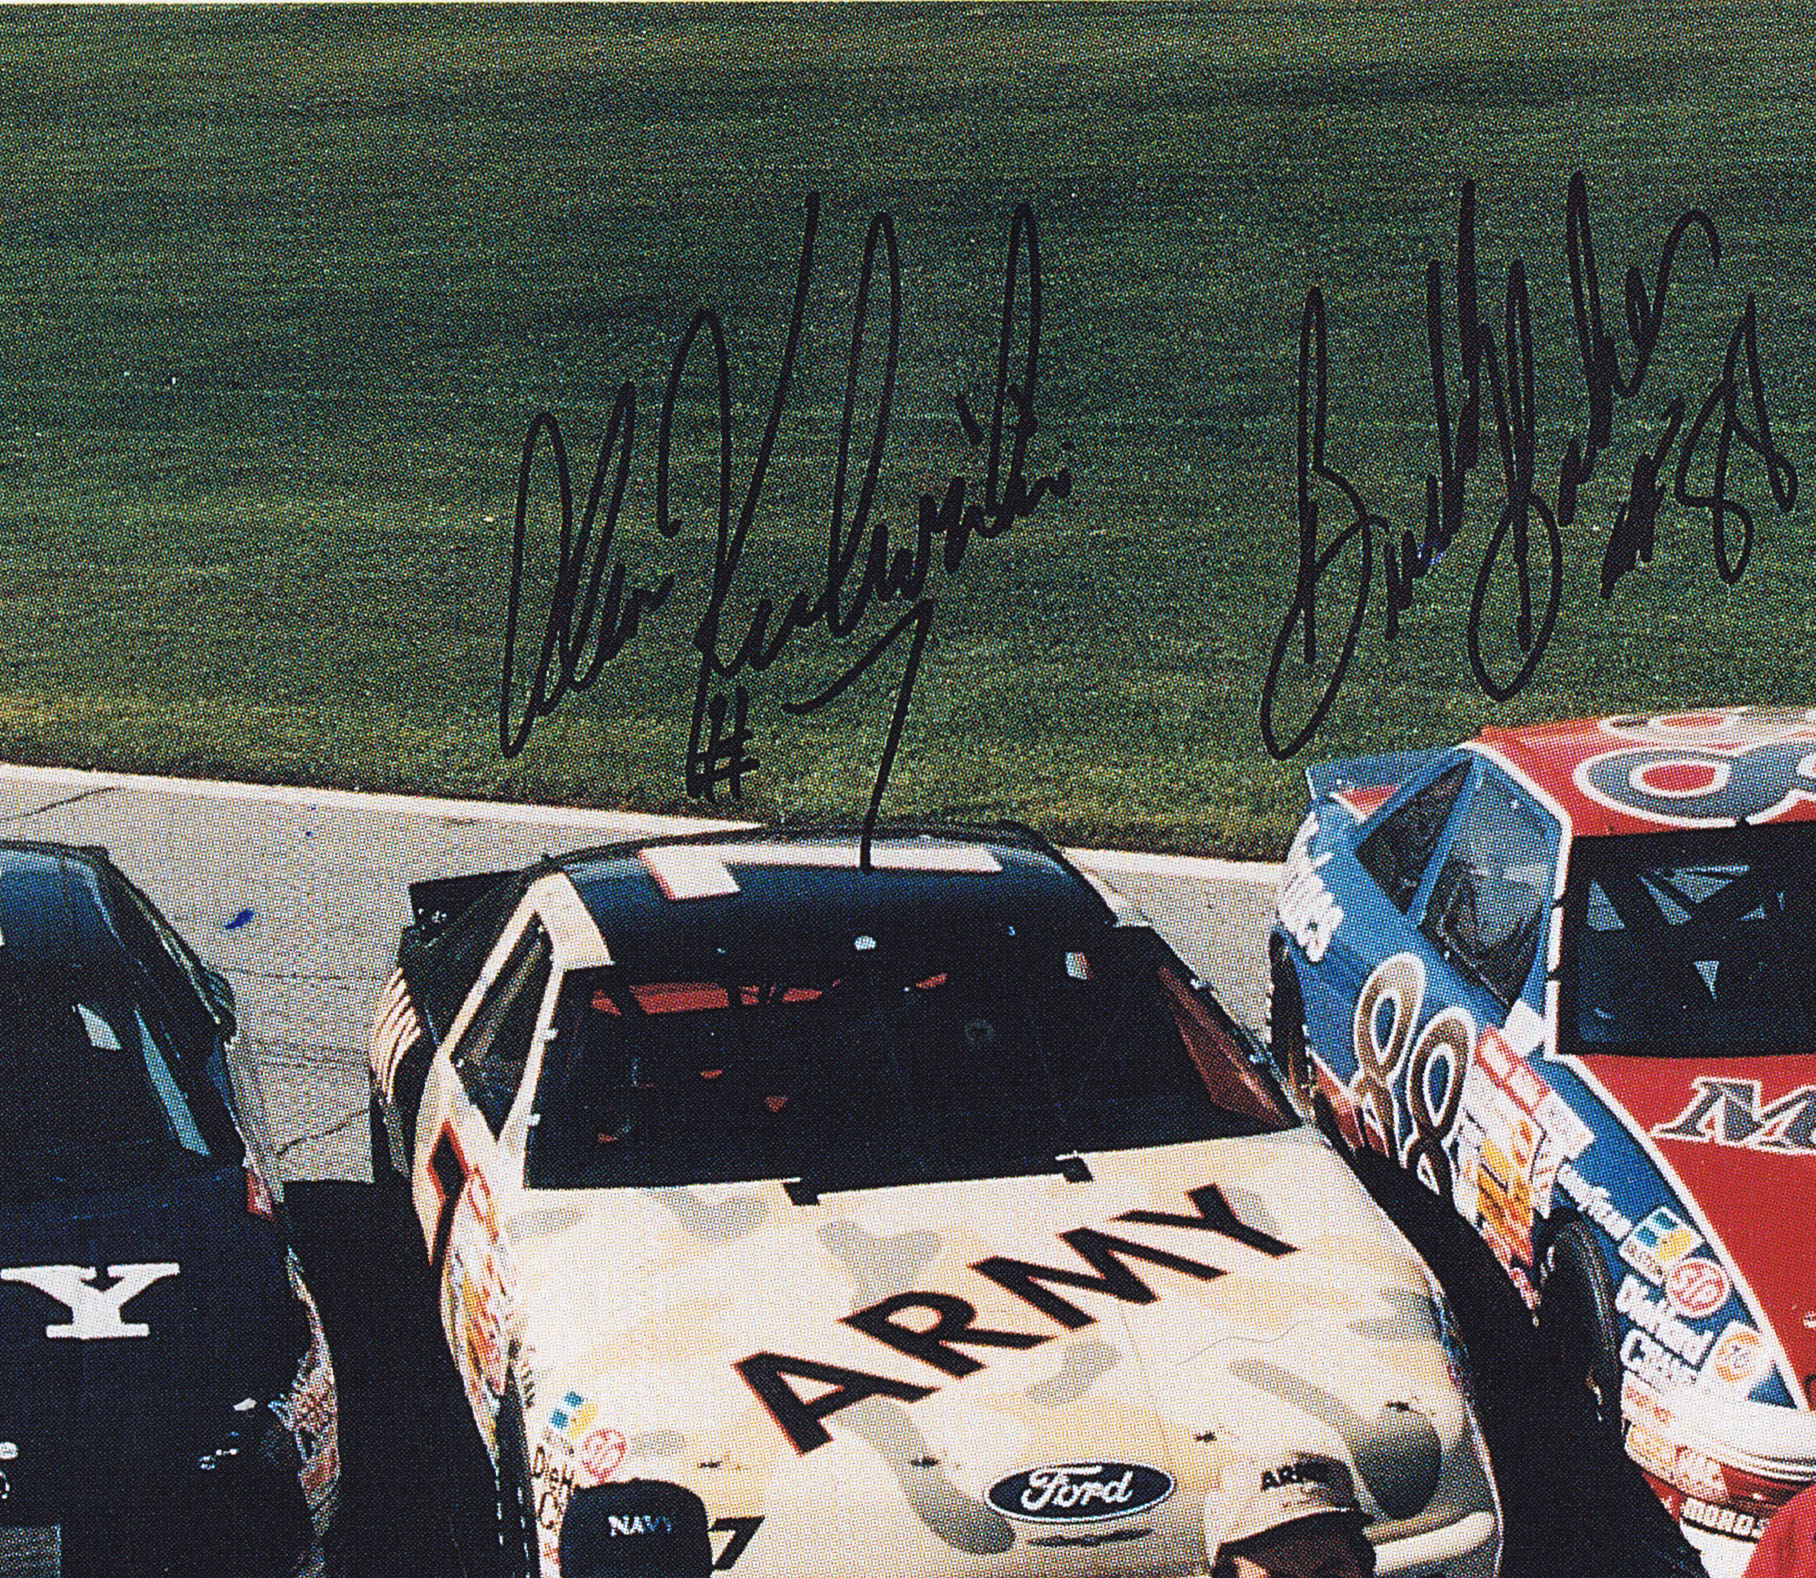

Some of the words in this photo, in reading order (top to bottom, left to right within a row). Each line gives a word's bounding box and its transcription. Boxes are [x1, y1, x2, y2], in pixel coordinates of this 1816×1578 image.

[1672, 1263, 1726, 1311] STP
[734, 1182, 1300, 1457] ARMY
[1019, 1464, 1134, 1511] Ford
[607, 1513, 674, 1538] NAVY
[707, 1514, 766, 1571] 7
